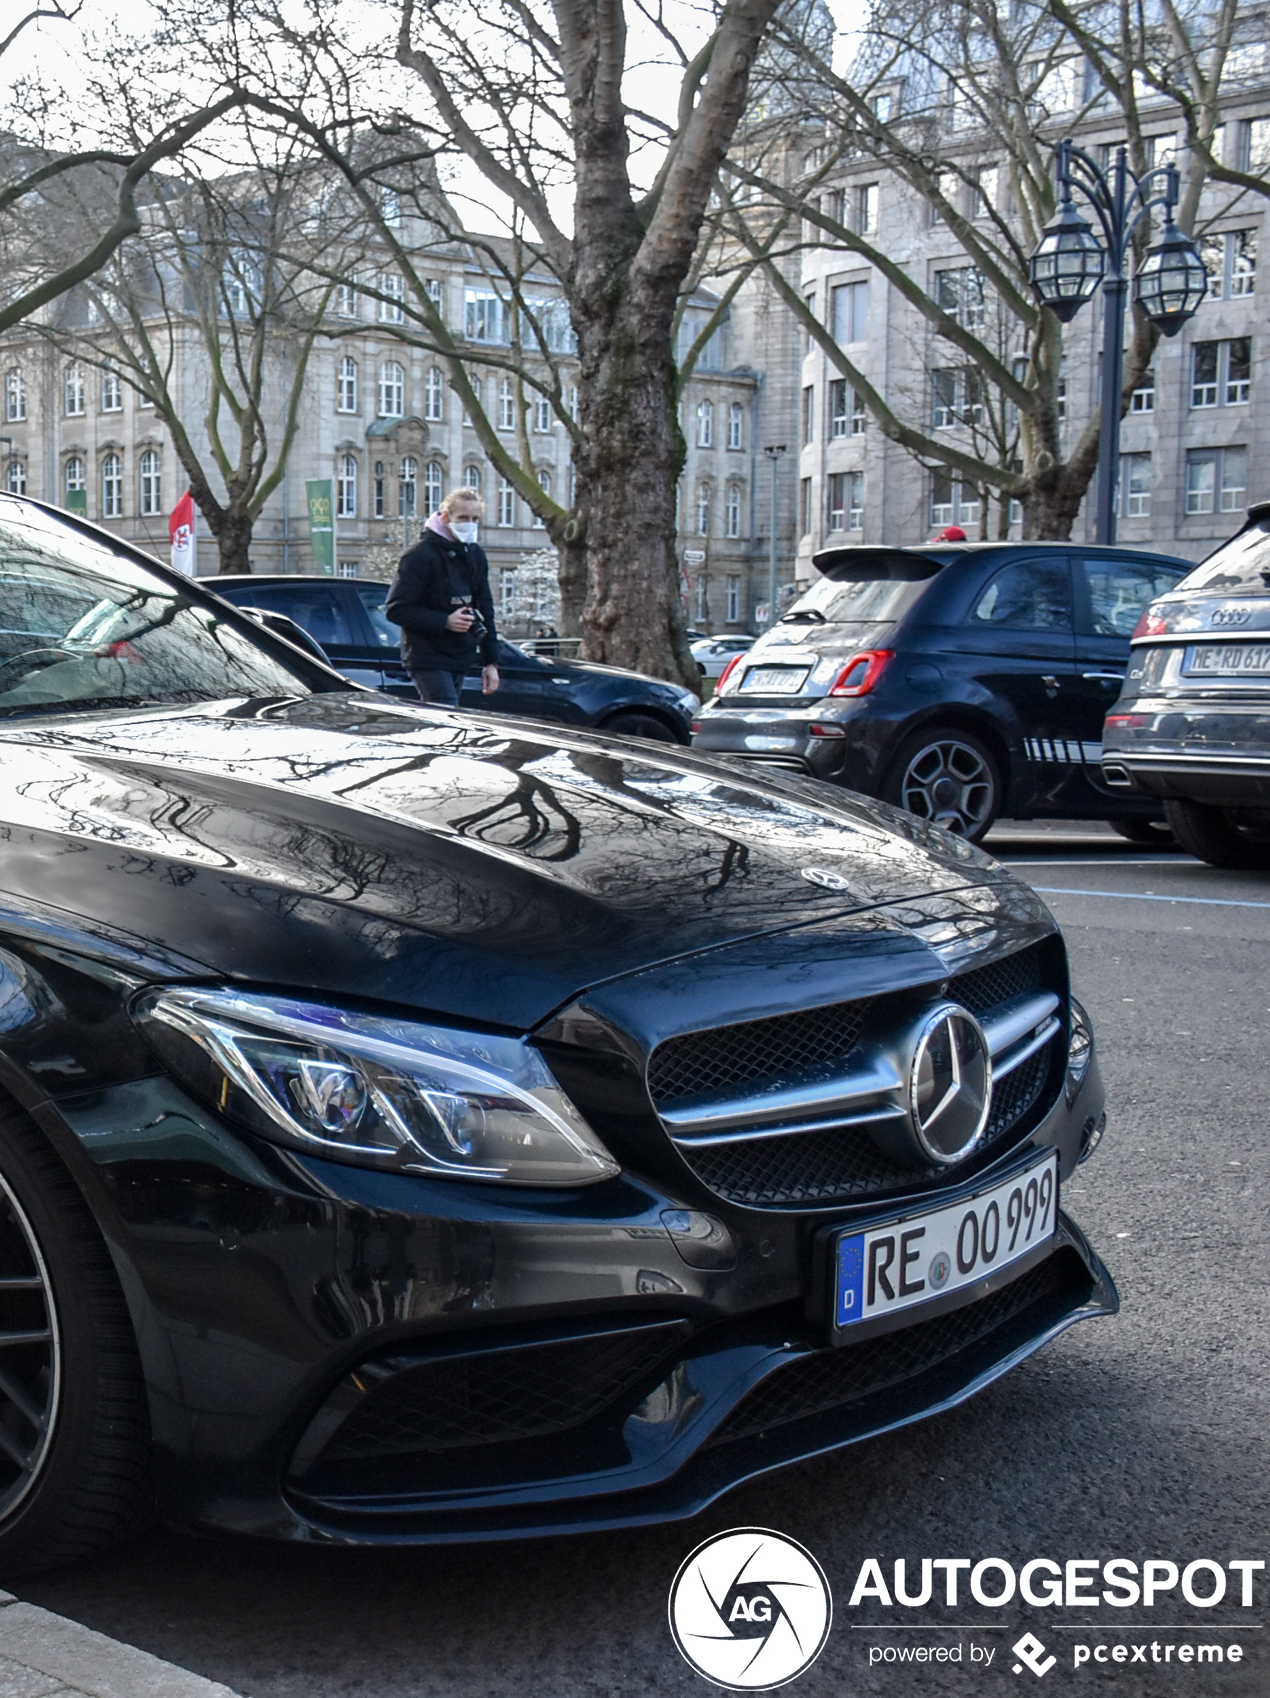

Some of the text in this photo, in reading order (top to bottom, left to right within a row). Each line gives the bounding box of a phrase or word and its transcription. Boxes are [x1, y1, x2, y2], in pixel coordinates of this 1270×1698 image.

[1192, 648, 1213, 669] ME
[1221, 648, 1243, 669] RD
[867, 1226, 926, 1306] RE
[1006, 1167, 1053, 1252] 999
[844, 1289, 854, 1309] D
